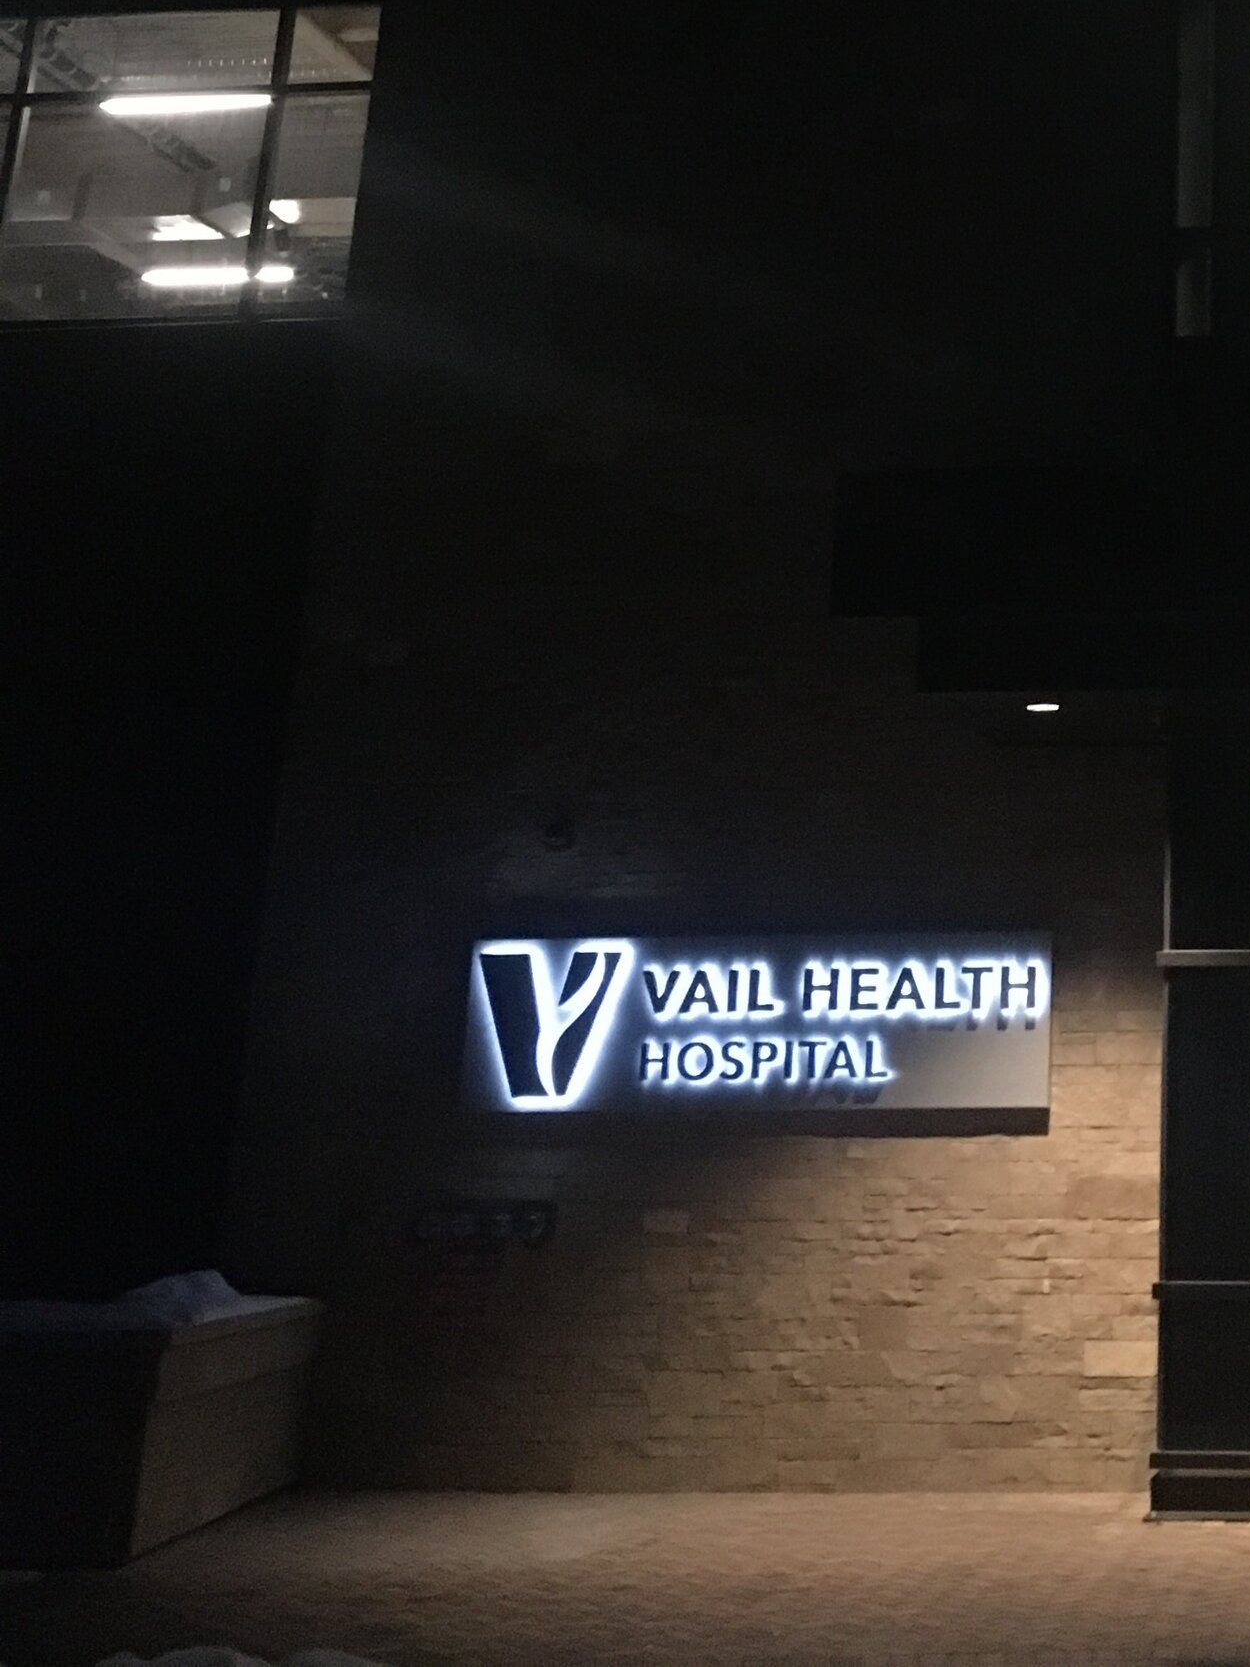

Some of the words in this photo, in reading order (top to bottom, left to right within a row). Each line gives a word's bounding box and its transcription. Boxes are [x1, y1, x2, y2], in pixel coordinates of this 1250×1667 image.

[642, 968, 775, 1015] VAIL
[801, 965, 1037, 1011] HEALTH
[639, 1040, 889, 1081] HOSPITAL
